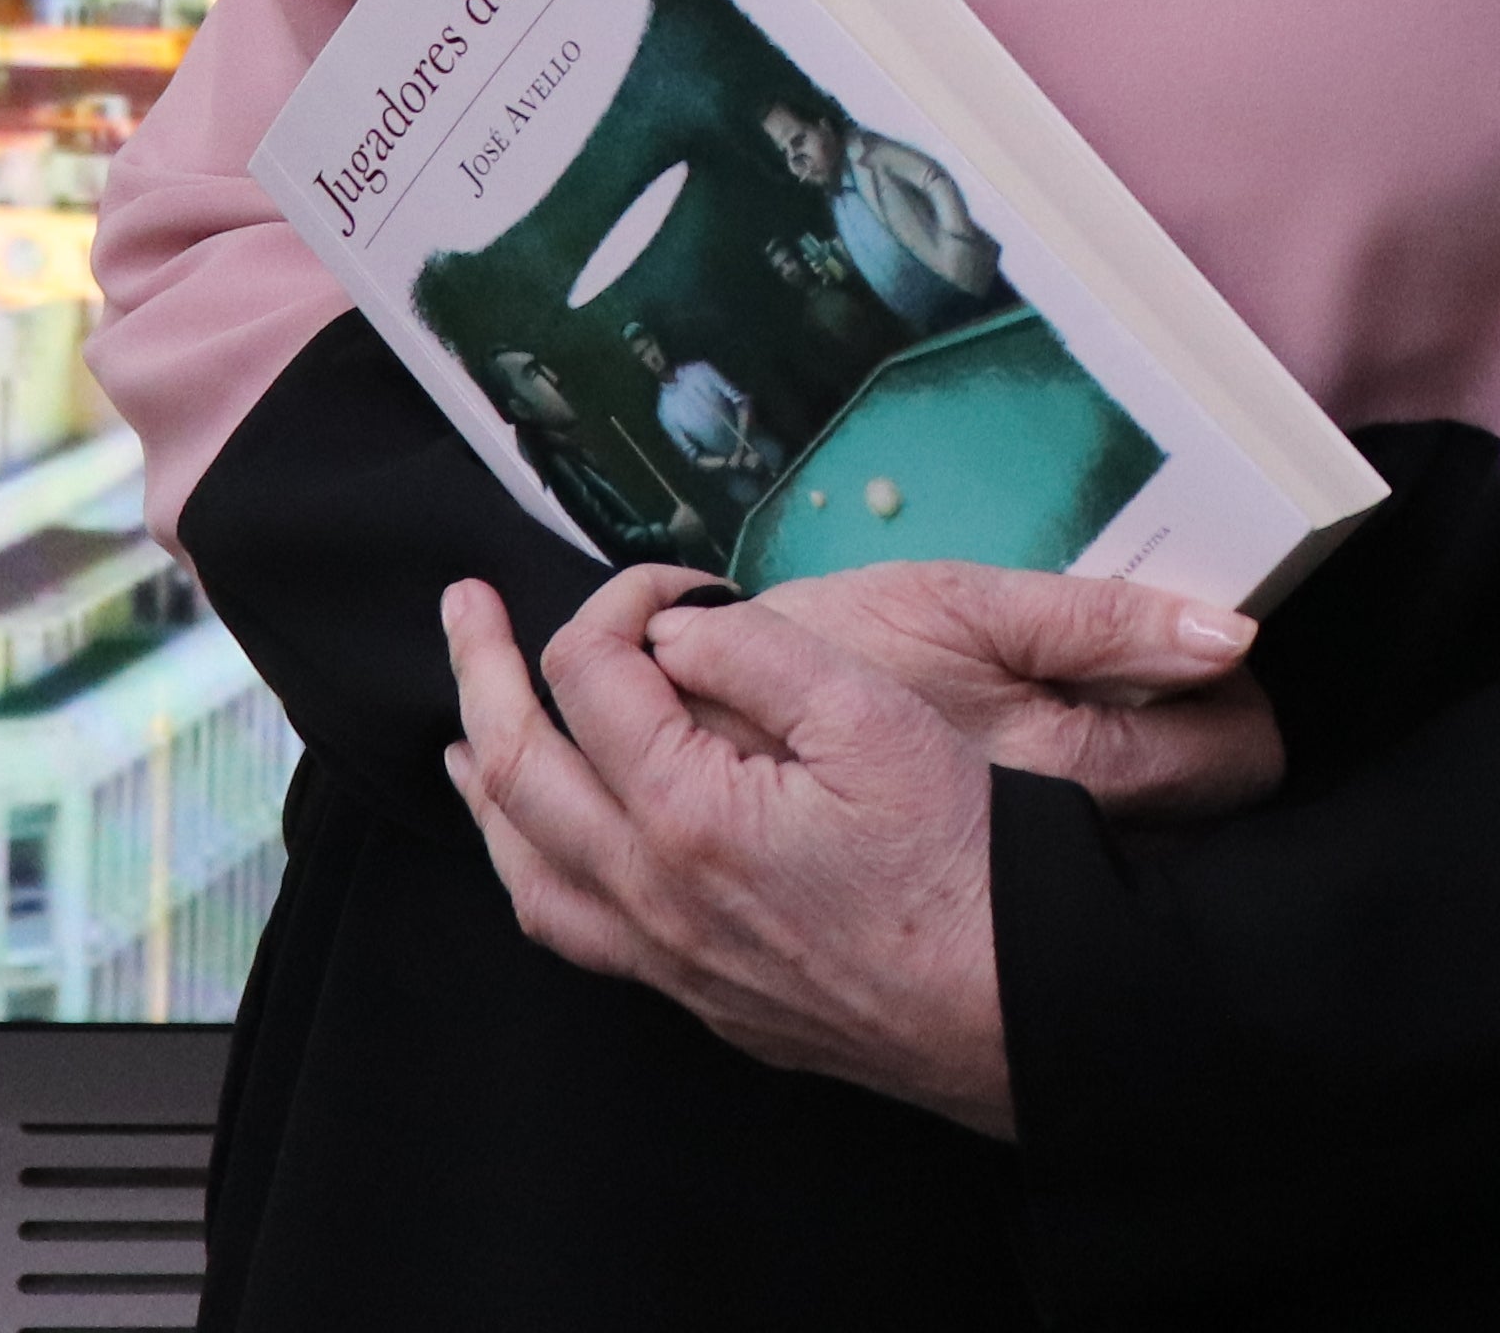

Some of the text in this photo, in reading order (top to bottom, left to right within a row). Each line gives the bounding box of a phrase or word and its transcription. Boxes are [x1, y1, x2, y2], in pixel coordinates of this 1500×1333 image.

[312, 25, 469, 238] Jugadores
[458, 39, 583, 199] JOSÉ AVELLO
